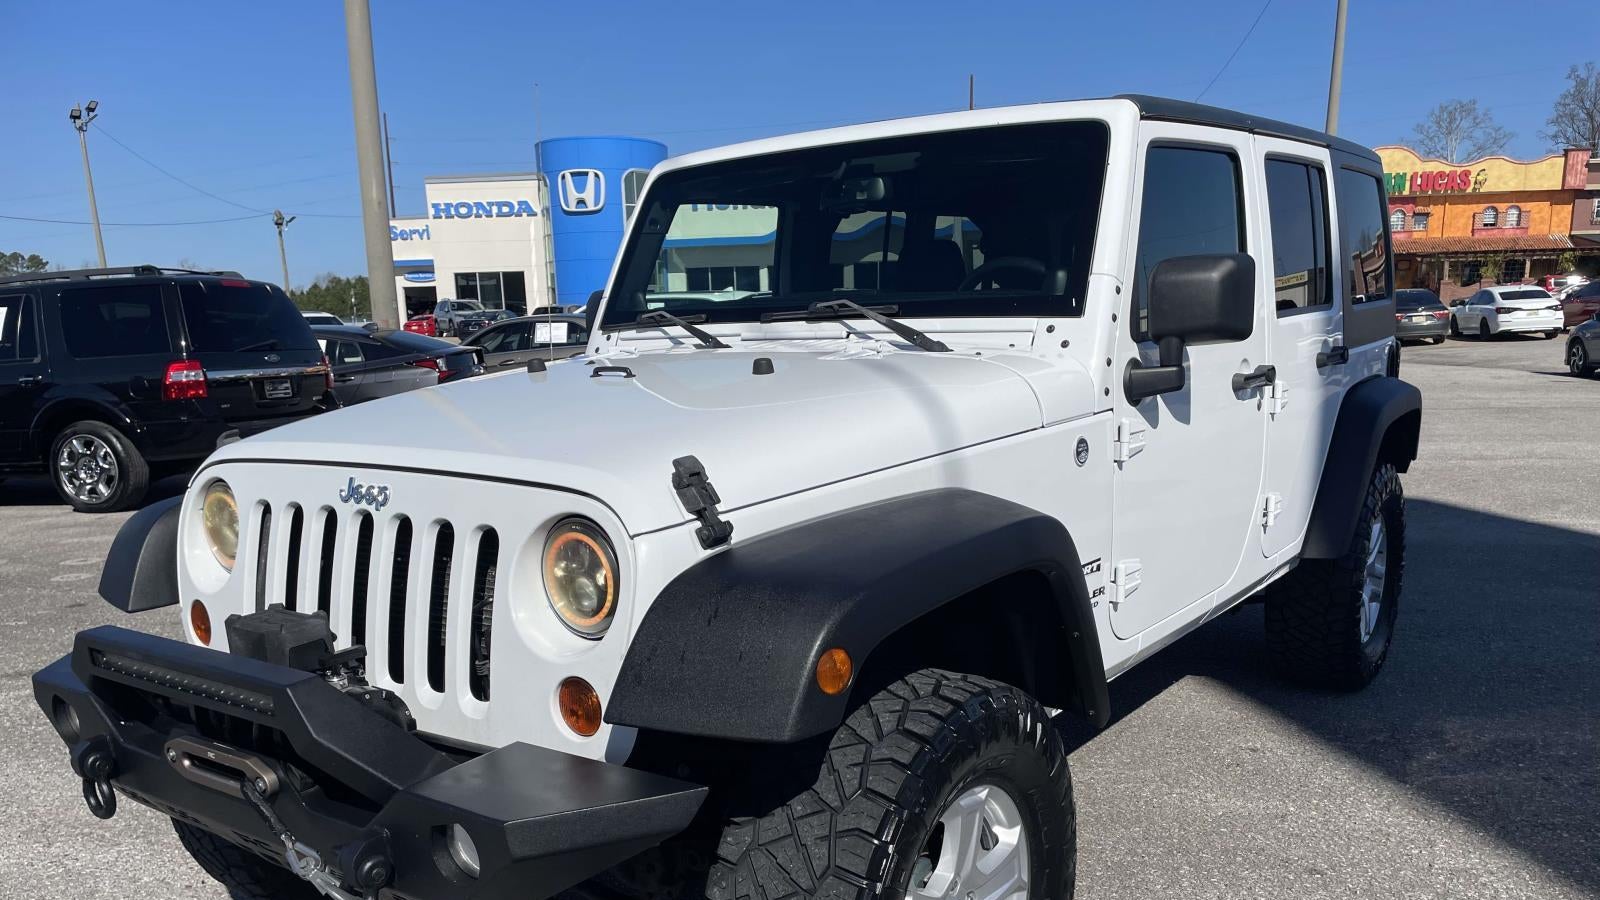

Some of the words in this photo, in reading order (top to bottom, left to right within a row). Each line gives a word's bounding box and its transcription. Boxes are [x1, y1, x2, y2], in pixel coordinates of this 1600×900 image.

[1410, 169, 1472, 193] LUCAS
[431, 200, 537, 219] HONDA
[390, 224, 431, 241] Servi
[339, 476, 390, 511] Jeep
